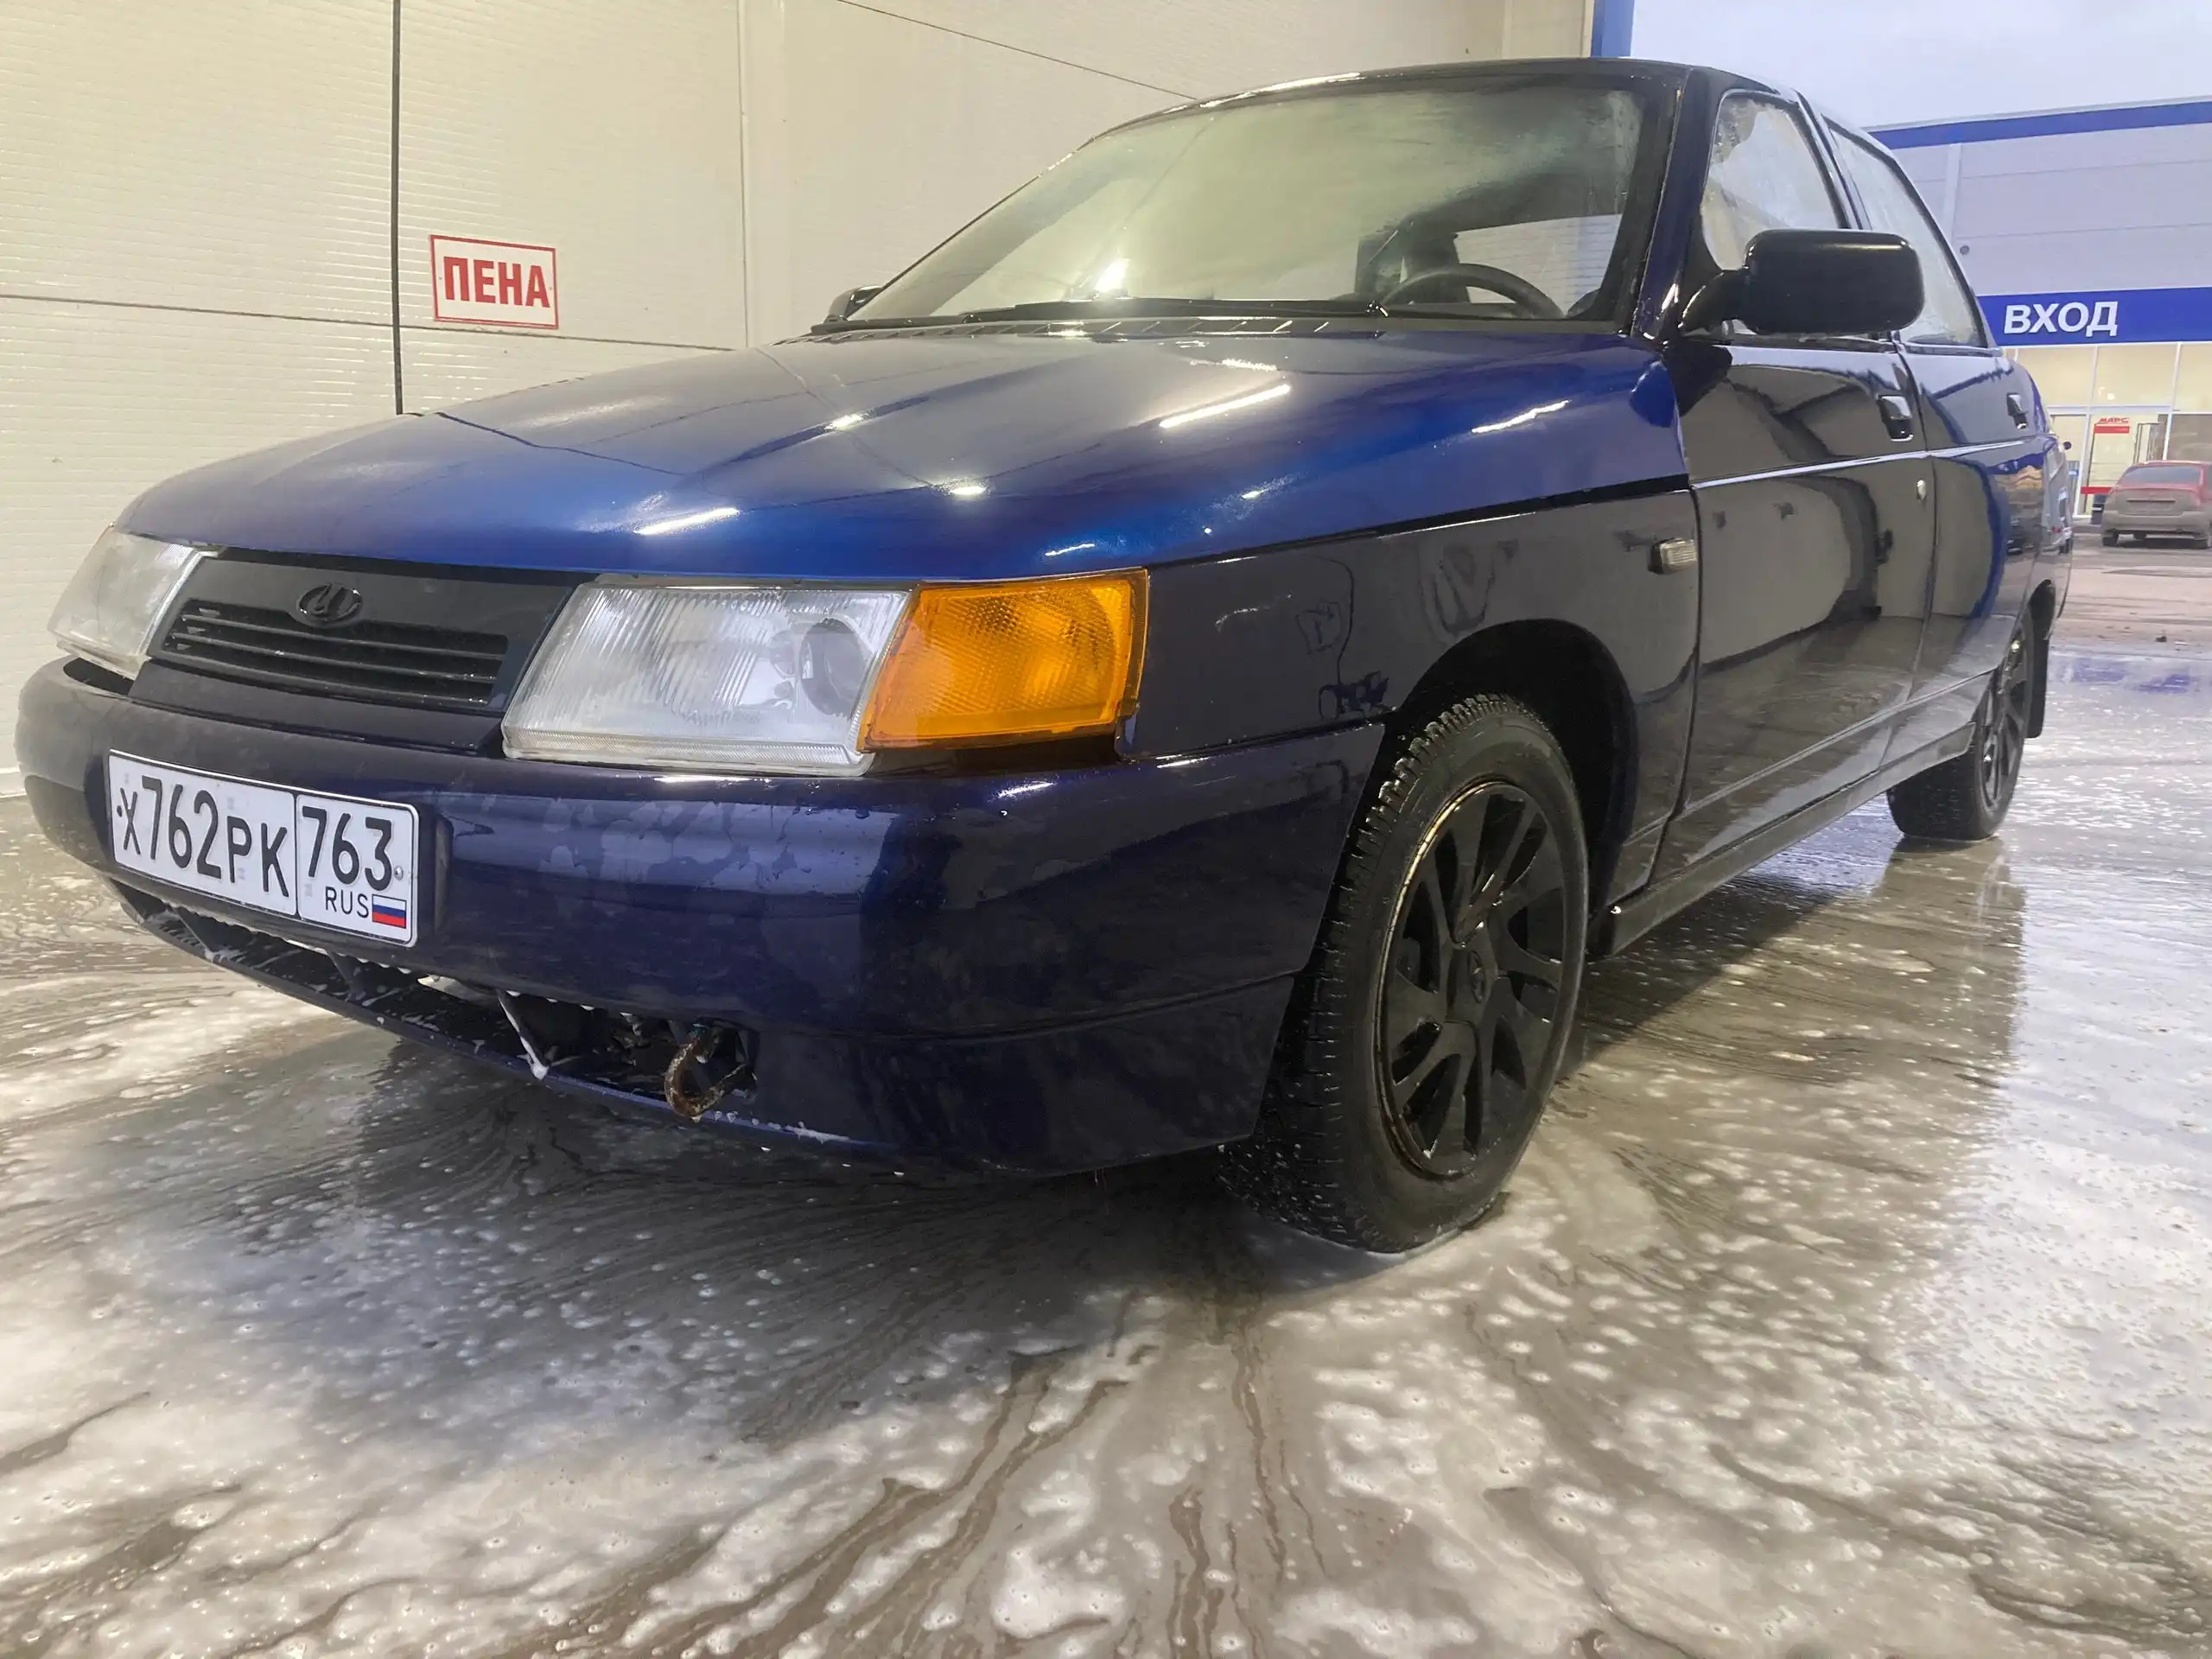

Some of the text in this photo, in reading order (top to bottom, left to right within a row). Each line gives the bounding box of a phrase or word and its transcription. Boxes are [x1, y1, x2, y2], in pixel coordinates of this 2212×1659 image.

[443, 256, 550, 308] ПЕНА
[2004, 301, 2119, 337] ВХОД
[302, 805, 393, 892] 763
[325, 886, 370, 918] RUS
